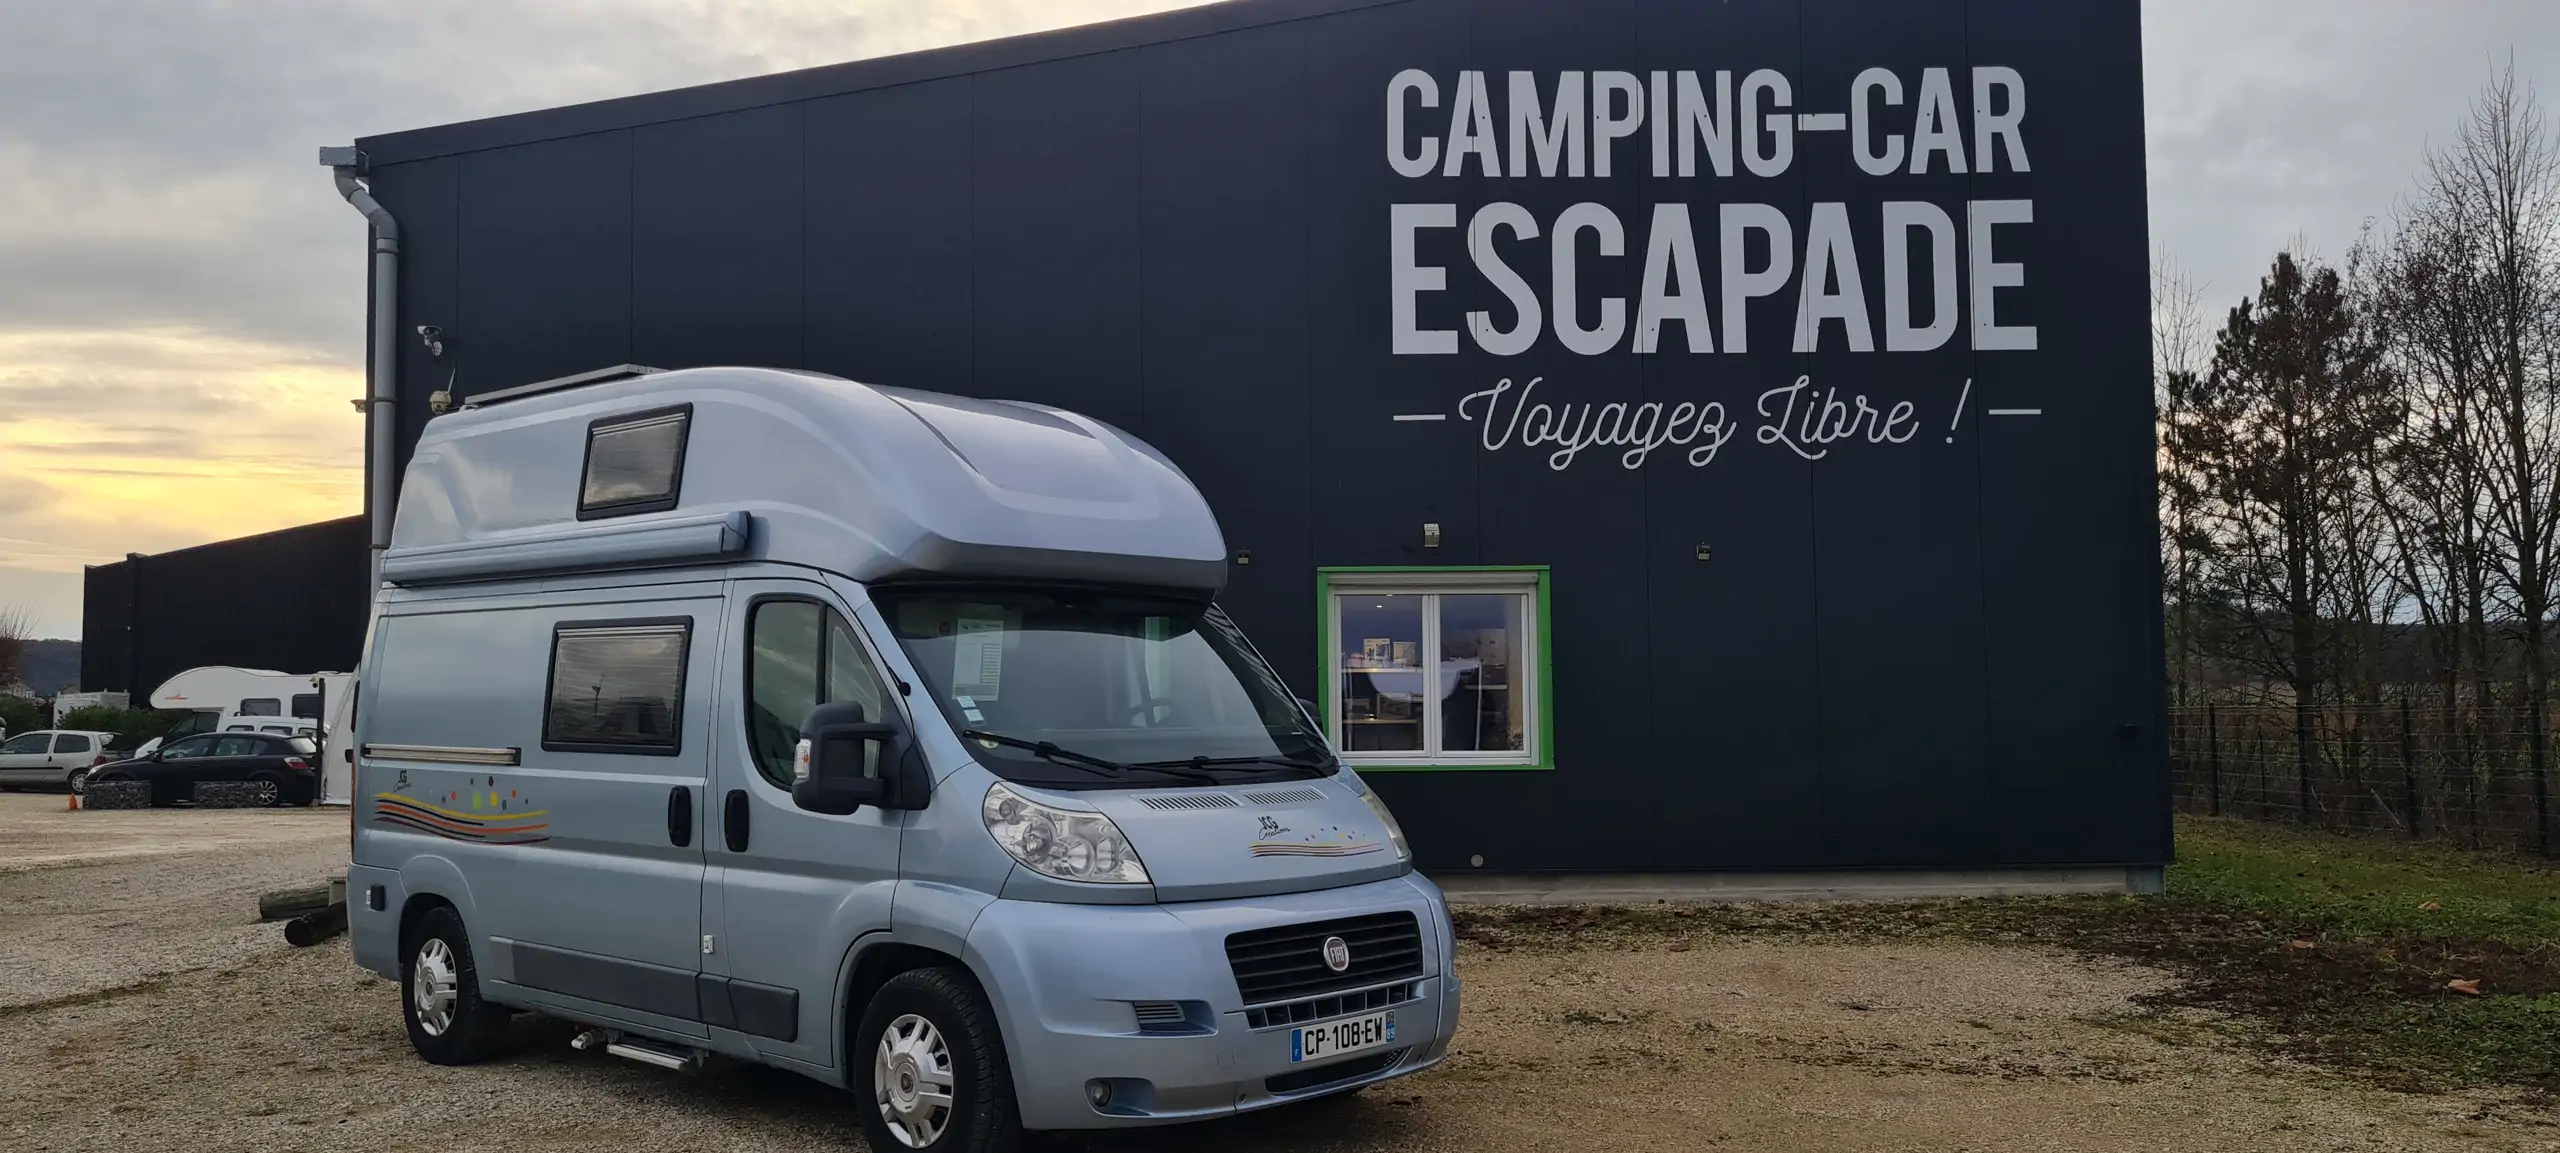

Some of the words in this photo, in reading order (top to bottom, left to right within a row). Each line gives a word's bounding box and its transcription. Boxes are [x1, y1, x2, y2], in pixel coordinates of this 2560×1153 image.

[1386, 66, 2032, 178] CAMPING-CAR
[1390, 199, 2039, 356] ESCAPADE
[1458, 376, 1737, 471] Voyagez
[1756, 374, 1920, 461] Libre
[1945, 378, 1972, 445] !
[1257, 815, 1279, 830] JCG
[1329, 946, 1345, 964] FIAT
[1304, 1016, 1383, 1056] CP-108-EW
[1386, 1027, 1396, 1041] 89
